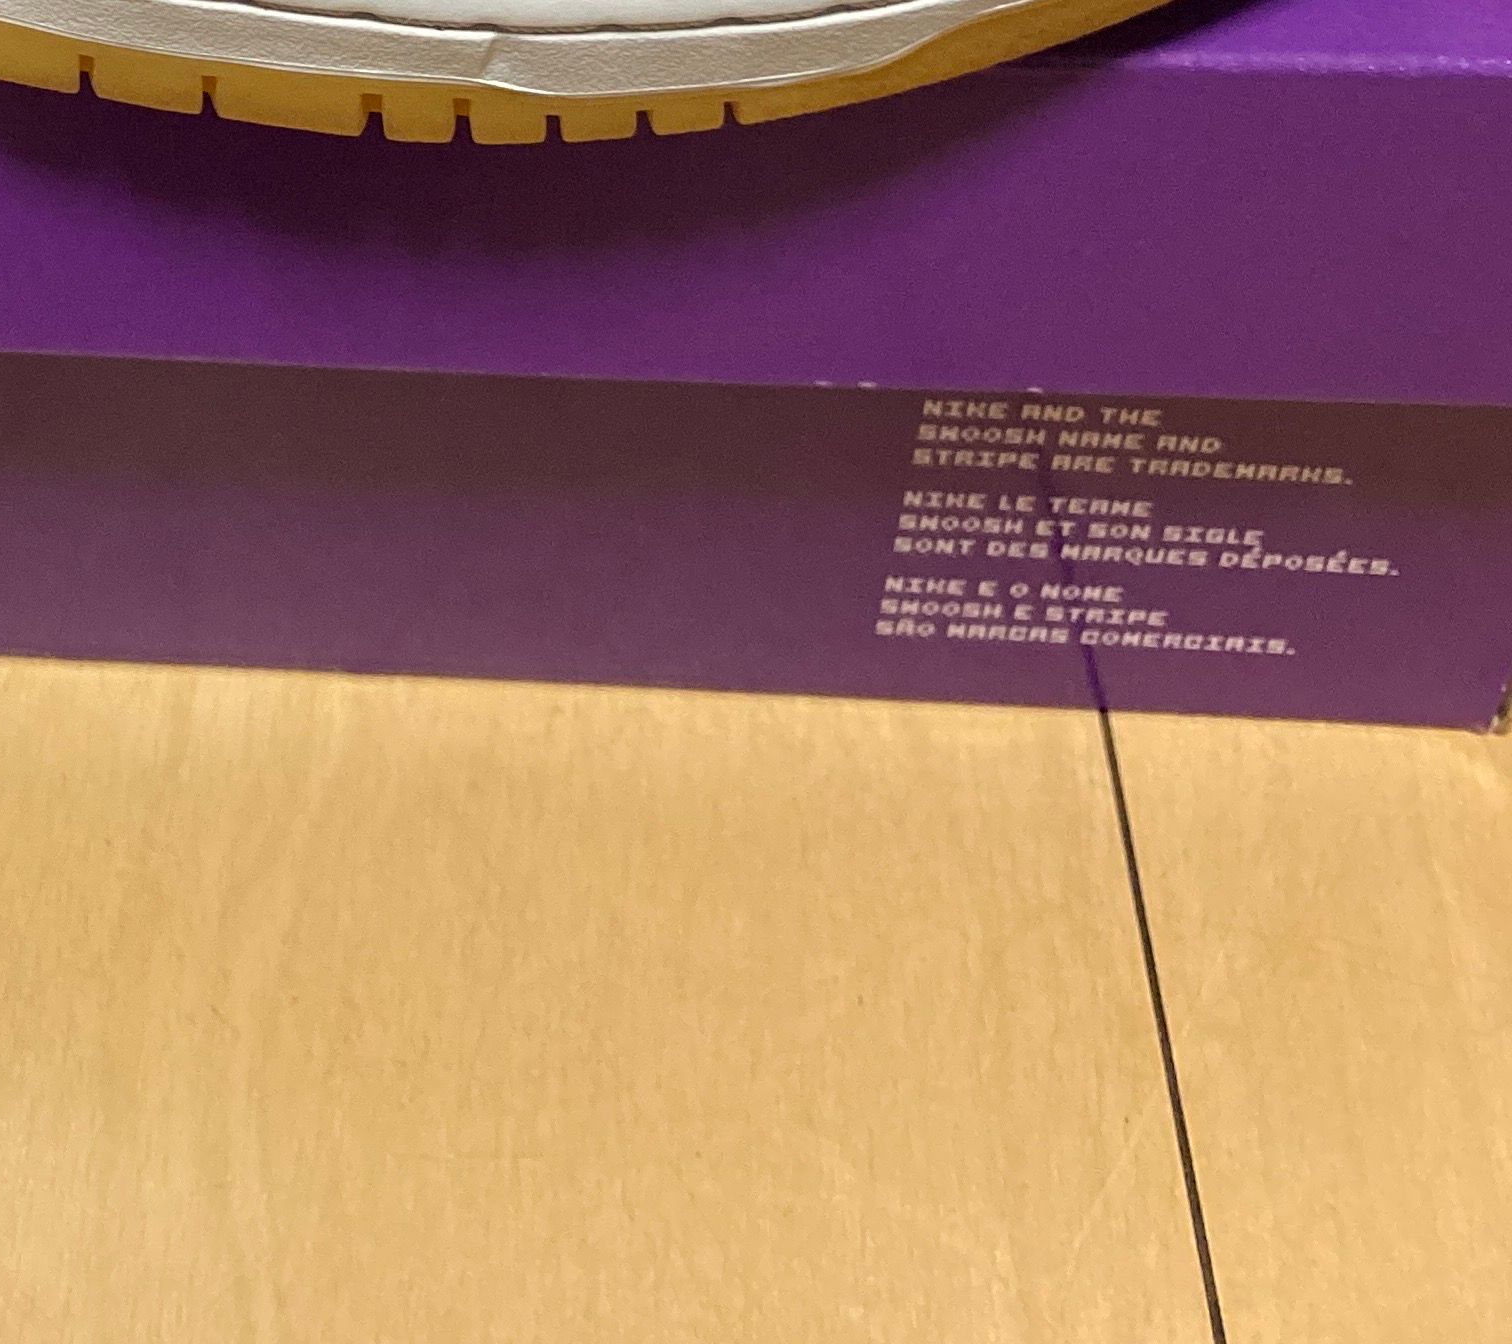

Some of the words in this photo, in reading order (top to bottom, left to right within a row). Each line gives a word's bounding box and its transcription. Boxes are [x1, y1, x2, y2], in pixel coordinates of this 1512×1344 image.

[923, 399, 1008, 420] NIKE
[1021, 403, 1086, 423] AND
[1100, 406, 1162, 427] THE
[1058, 429, 1145, 450] NAME
[1156, 433, 1224, 454] AND
[912, 447, 1040, 470] STRIPE
[1050, 453, 1117, 474] ARE
[1128, 457, 1353, 485] TRADEMARKS.
[902, 490, 987, 510] NIKE
[998, 494, 1037, 513] LE
[1049, 495, 1153, 518] TERME
[1035, 519, 1077, 538] ET
[1088, 521, 1152, 541] SON
[1162, 523, 1264, 547] SIGLE
[893, 535, 976, 556] SONT
[986, 540, 1050, 559] DES
[1060, 543, 1209, 567] MARQUES
[884, 575, 967, 596] NIKE
[977, 579, 998, 598] E
[1009, 581, 1030, 599] O
[1040, 582, 1124, 603] NOME
[1013, 603, 1035, 621] E
[1045, 604, 1169, 627] STRIPE
[946, 622, 1070, 644] MARCAS
[1079, 629, 1296, 655] COMERCIAIS.
